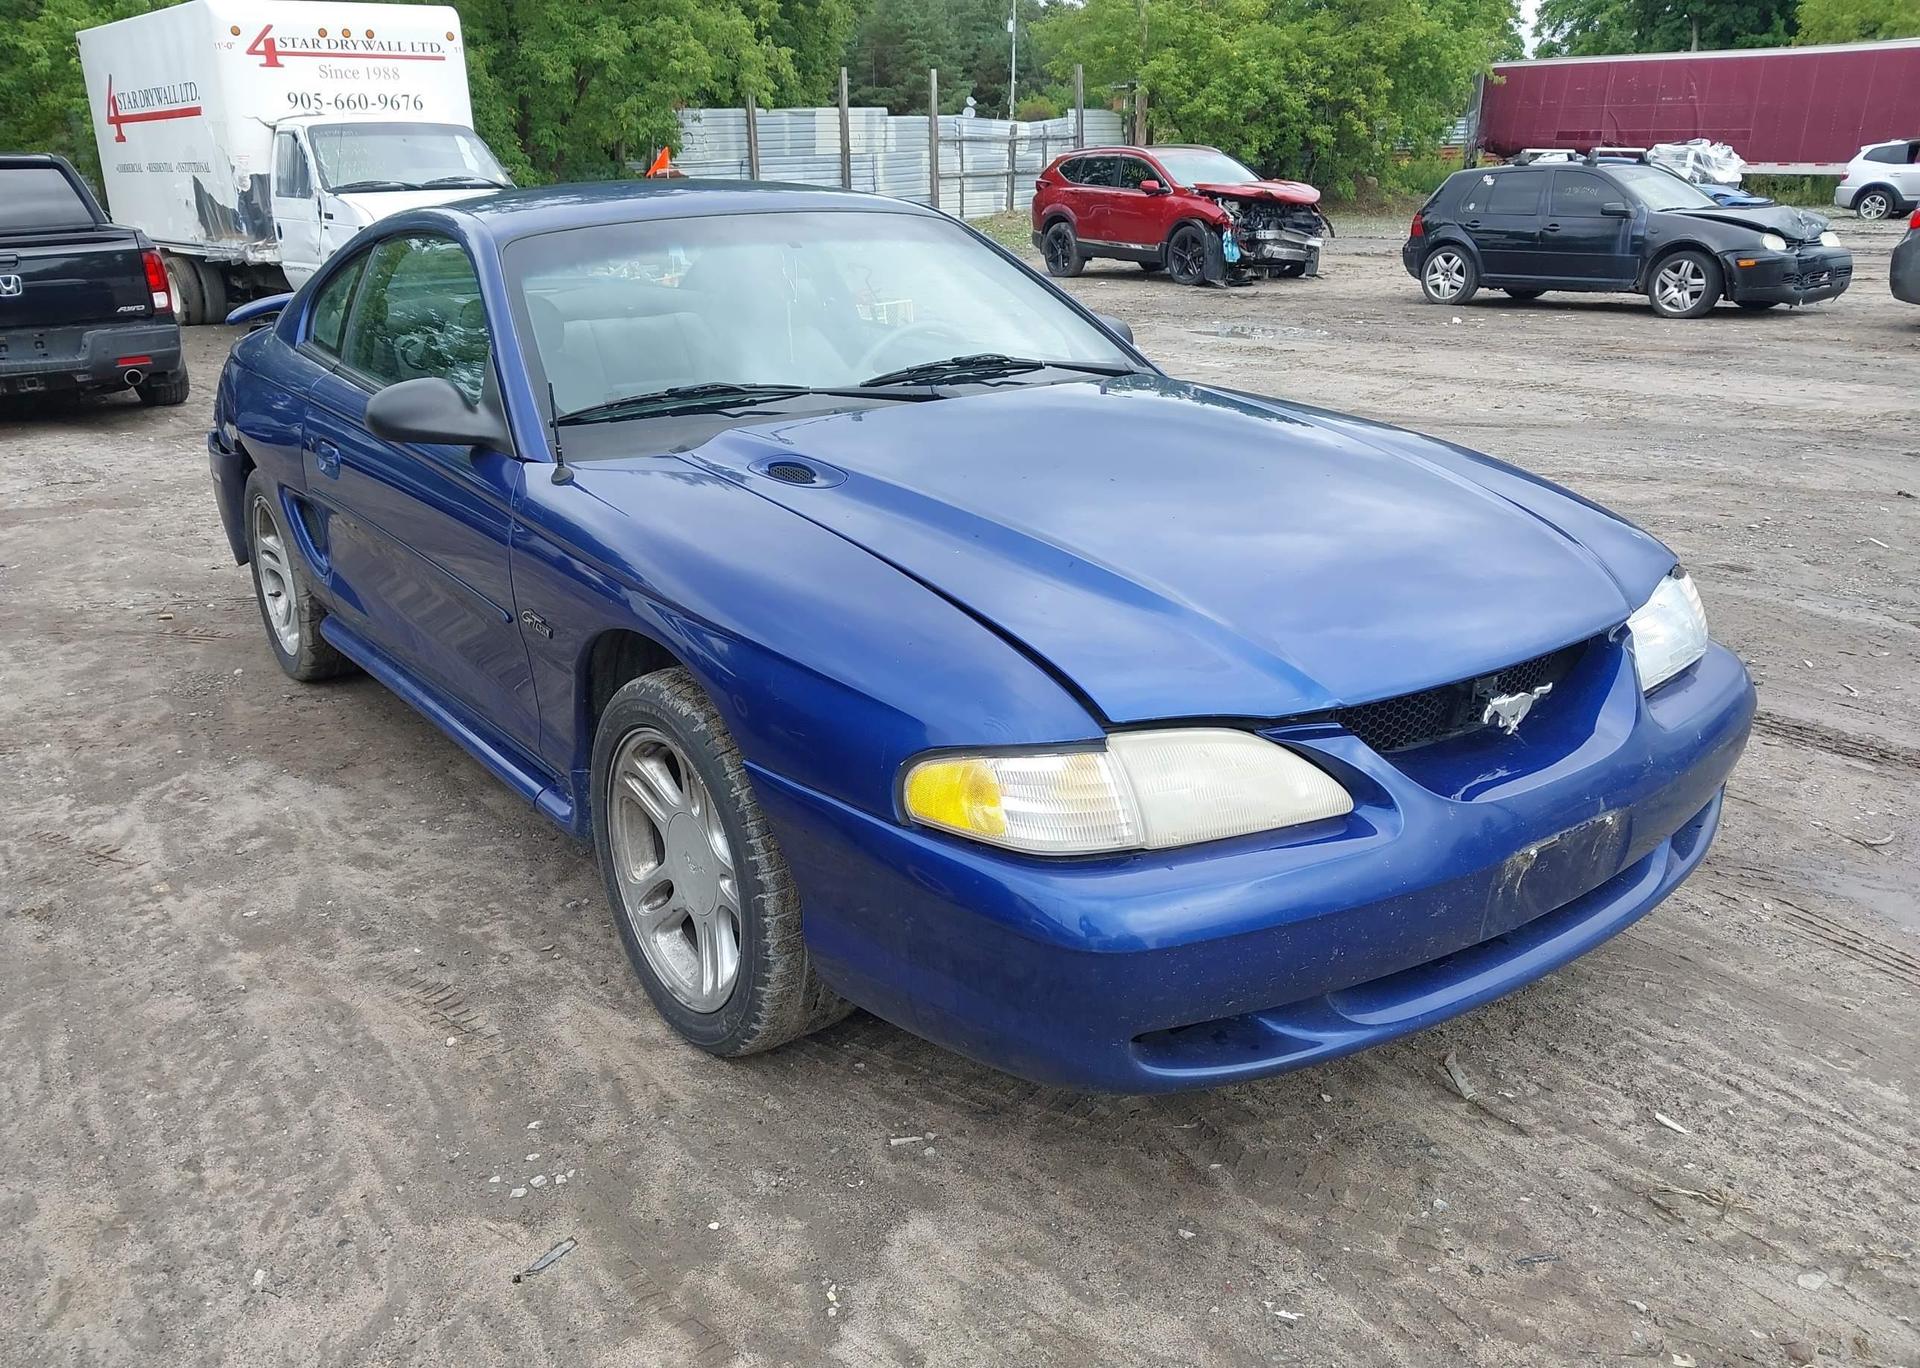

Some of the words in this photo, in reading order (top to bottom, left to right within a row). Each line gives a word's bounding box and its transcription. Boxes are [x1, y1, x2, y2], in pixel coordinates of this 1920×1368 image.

[246, 24, 284, 68] 4
[279, 36, 321, 50] STAR
[327, 38, 408, 53] DRYWALL
[411, 41, 446, 54] LTD.
[318, 64, 360, 80] Since
[366, 66, 400, 81] 1988
[107, 73, 126, 143] 4
[117, 91, 139, 111] STAR
[139, 85, 179, 108] DRYWALL
[179, 81, 201, 103] LTD.
[287, 92, 424, 111] 905-660-9676
[116, 304, 146, 313] AWD
